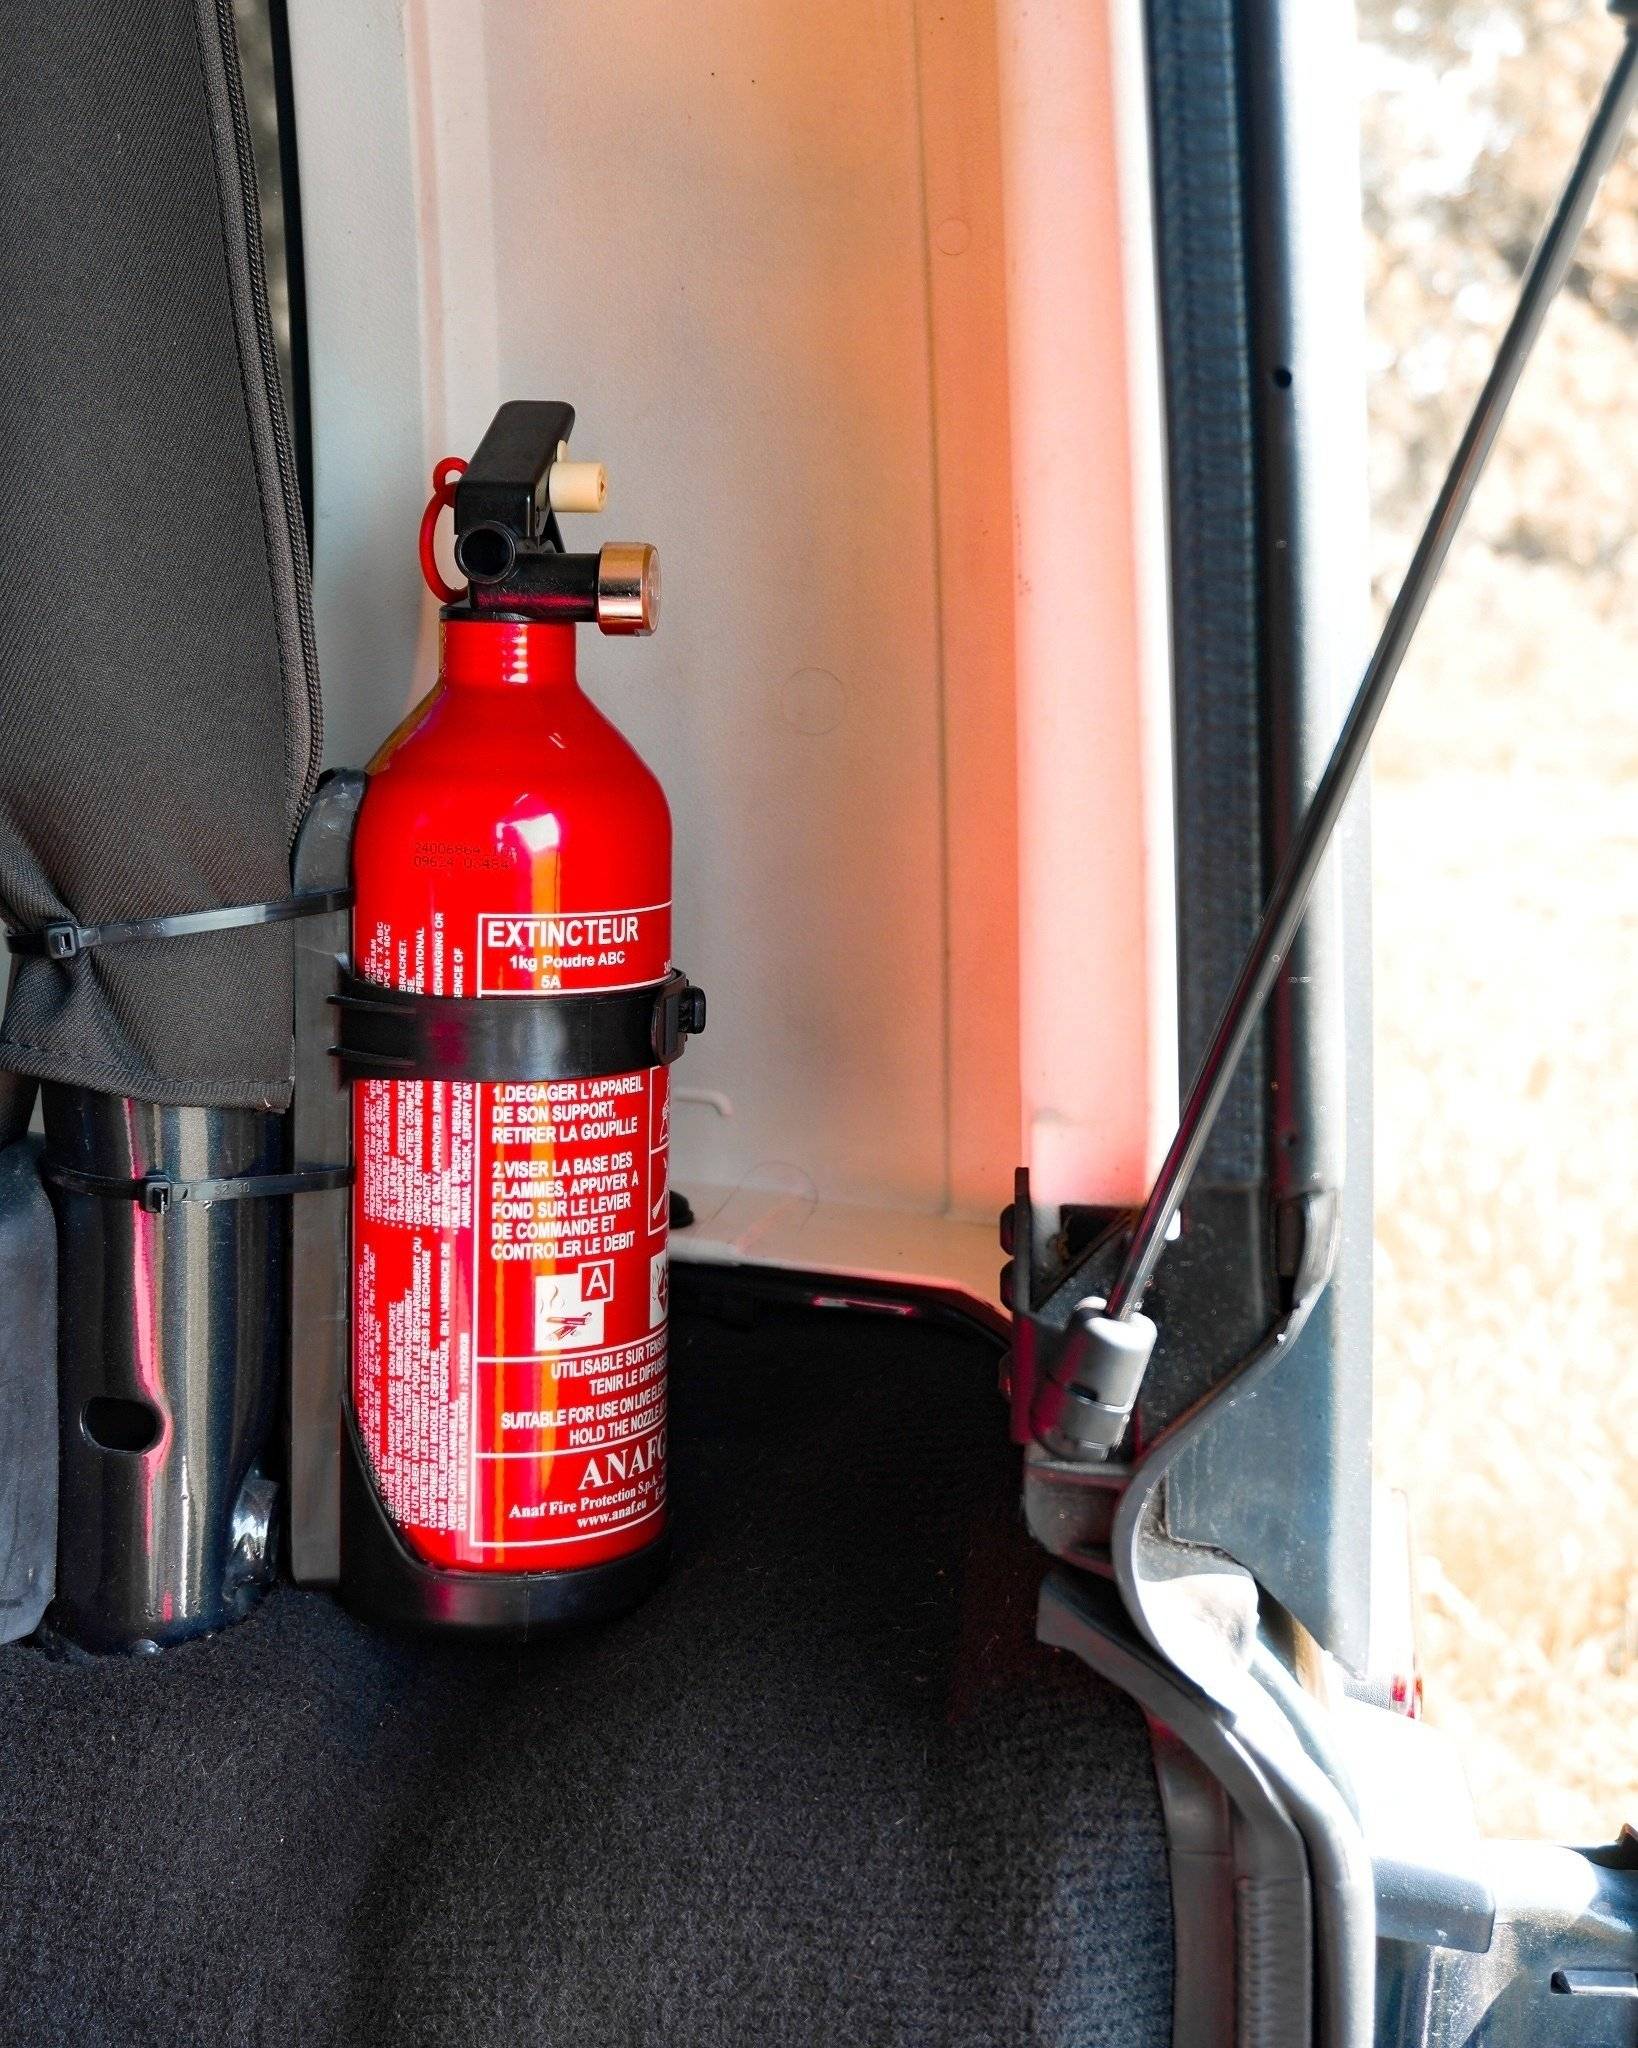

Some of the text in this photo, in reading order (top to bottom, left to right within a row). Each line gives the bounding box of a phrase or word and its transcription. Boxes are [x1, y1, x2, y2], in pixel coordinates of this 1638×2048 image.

[435, 912, 443, 928] OR
[487, 917, 639, 948] EXTINCTEUR
[399, 939, 407, 992] BRACKET.
[416, 927, 424, 994] PERATIONAL
[434, 931, 443, 995] ECHARGING
[454, 948, 463, 963] OF
[510, 951, 625, 972] 1kg Poudre ABC
[541, 976, 561, 989] 5A
[492, 1076, 644, 1102] 1.DEGAGER L'APPAREIL
[492, 1100, 616, 1123] DE SON SUPPORT,
[406, 1128, 414, 1163] AFTER
[414, 1107, 423, 1186] EXTINGUISHER
[432, 1115, 442, 1173] APPROVED
[492, 1116, 638, 1144] RETIRER LA GOUPILLE
[451, 1136, 461, 1184] SPECIFIC
[461, 1102, 473, 1228] ANNUAL CHECK, EXPIRY
[492, 1151, 633, 1178] 2.VISER LA BASE DES
[397, 1157, 405, 1221] TRANSPORT
[405, 1164, 413, 1223] RECHARGE
[432, 1174, 441, 1203] ONLY
[492, 1180, 568, 1199] FLAMMES,
[570, 1174, 628, 1196] APPUYER
[413, 1188, 422, 1224] CHECK
[431, 1205, 441, 1227] USE
[451, 1186, 461, 1228] UNLESS
[492, 1192, 631, 1219] FOND SUR LE LEVIER
[492, 1214, 616, 1240] DE COMMANDE ET
[441, 1242, 450, 1258] DE
[491, 1231, 636, 1261] CONTROLER LE DEBIT
[440, 1259, 450, 1319] L'ABSENCE
[586, 1266, 608, 1297] A
[404, 1288, 412, 1382] PERIODIQUEMENT
[440, 1321, 449, 1336] EN
[388, 1354, 396, 1377] SON
[551, 1352, 624, 1379] UTILISABLE
[626, 1346, 644, 1367] SUR
[388, 1379, 396, 1407] AVEC
[411, 1237, 422, 1524] ET UTILISER UNIQUEMENT POUR LE RECHARGEMENT OU
[420, 1250, 431, 1527] L'ENTRETIEN LES PRODUITS ET PIECES DE RECHANGE
[589, 1374, 623, 1396] TENIR
[625, 1369, 638, 1389] LE
[430, 1400, 439, 1444] MODELE
[501, 1409, 566, 1430] SUITABLE
[569, 1407, 594, 1425] FOR
[596, 1400, 618, 1420] USE
[620, 1395, 634, 1415] ON
[635, 1388, 651, 1410] LIVE
[569, 1427, 605, 1447] HOLD
[608, 1418, 628, 1439] THE
[631, 1404, 659, 1432] NOZZLE
[395, 1419, 403, 1455] APRES
[430, 1445, 438, 1461] AU
[438, 1405, 448, 1498] REGLEMENTATION
[395, 1456, 403, 1521] RECHARGER
[403, 1459, 411, 1522] CONTROLER
[429, 1463, 438, 1528] CONFORMES
[448, 1460, 457, 1530] VERIFICATION
[458, 1467, 467, 1501] LIMITE
[438, 1501, 447, 1528] SAUF
[458, 1504, 467, 1530] DATE
[509, 1503, 546, 1518] Anaf
[548, 1501, 577, 1516] Fire
[580, 1486, 636, 1511] Protection
[577, 1499, 647, 1528] www.anaf.eu
